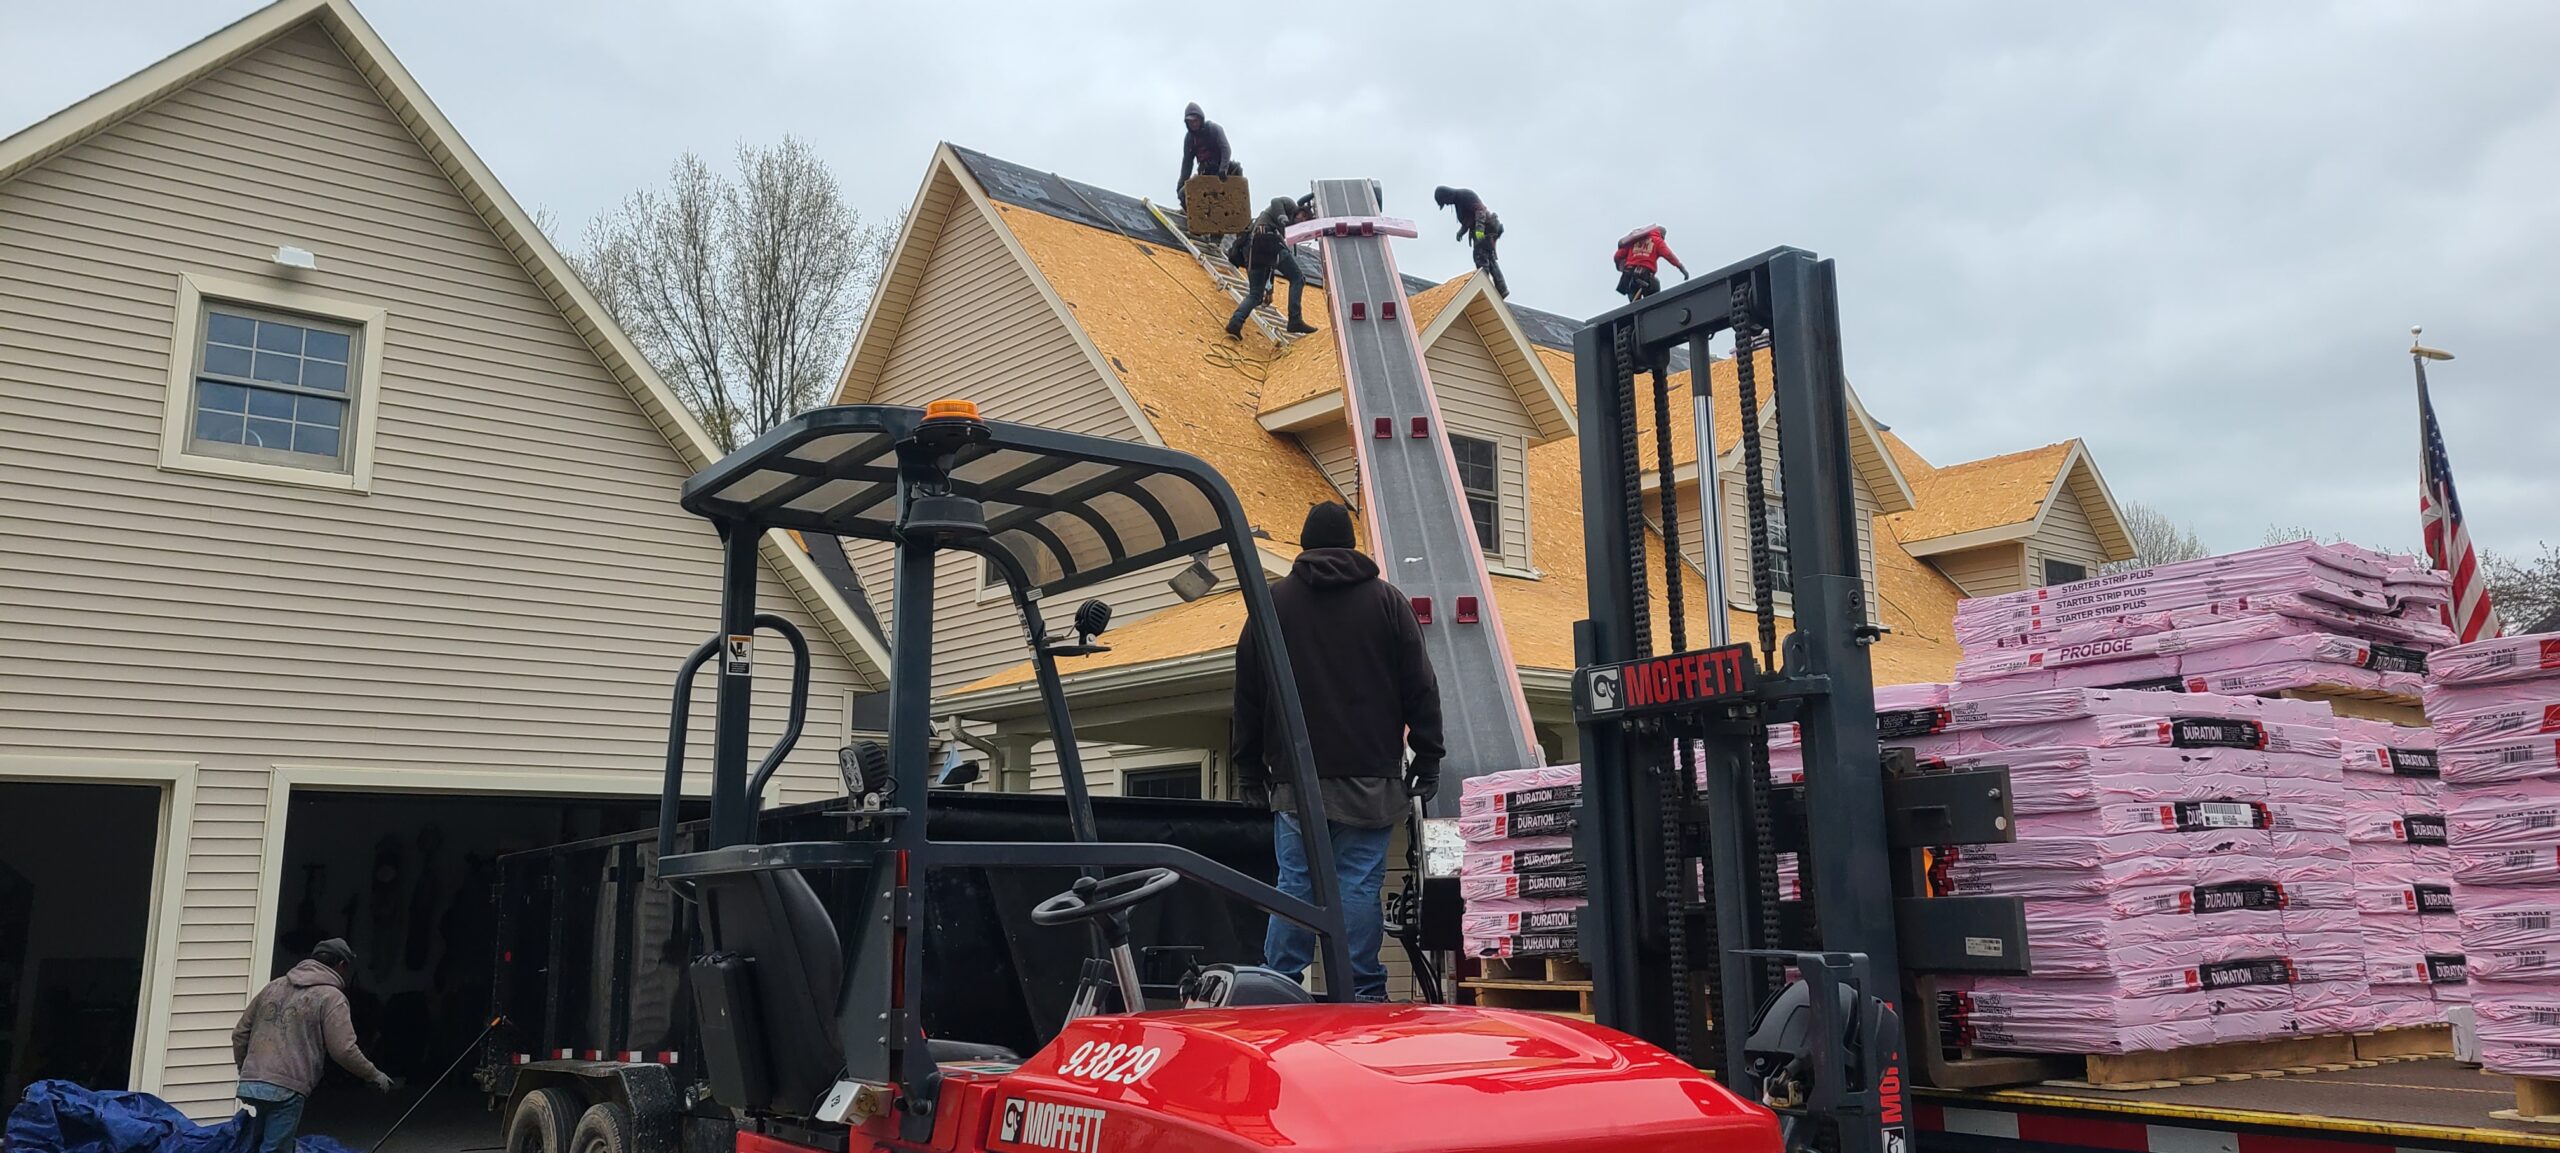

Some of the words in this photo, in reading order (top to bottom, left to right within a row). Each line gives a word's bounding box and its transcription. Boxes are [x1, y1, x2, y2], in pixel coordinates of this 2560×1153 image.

[2062, 579, 2100, 594] STARTER
[2102, 574, 2128, 587] STRIP
[2130, 569, 2154, 583] PLUS
[2056, 595, 2094, 609] STARTER
[2095, 591, 2122, 604] STRIP
[2123, 587, 2147, 600] PLUS
[2055, 610, 2093, 624] STARTER
[2094, 605, 2121, 619] STRIP
[2122, 600, 2147, 614] PLUS
[2060, 638, 2133, 661] PROEDGE
[2491, 647, 2518, 655] SABLE
[1624, 649, 1743, 705] MOFFETT
[2183, 726, 2223, 741] DURATION
[2504, 744, 2534, 752] SABLE
[2397, 753, 2430, 767] DURATION
[1516, 789, 1552, 805] DURATION
[1517, 814, 1554, 829] DURATION
[2412, 824, 2445, 838] DURATION
[1523, 853, 1561, 867] DURATION
[1528, 877, 1566, 890] DURATION
[2205, 893, 2243, 908] DURATION
[1531, 912, 1569, 926] DURATION
[1522, 936, 1559, 949] DURATION
[2211, 968, 2252, 985] DURATION
[1058, 1041, 1161, 1084] 93829
[1023, 1100, 1106, 1153] MOFFETT
